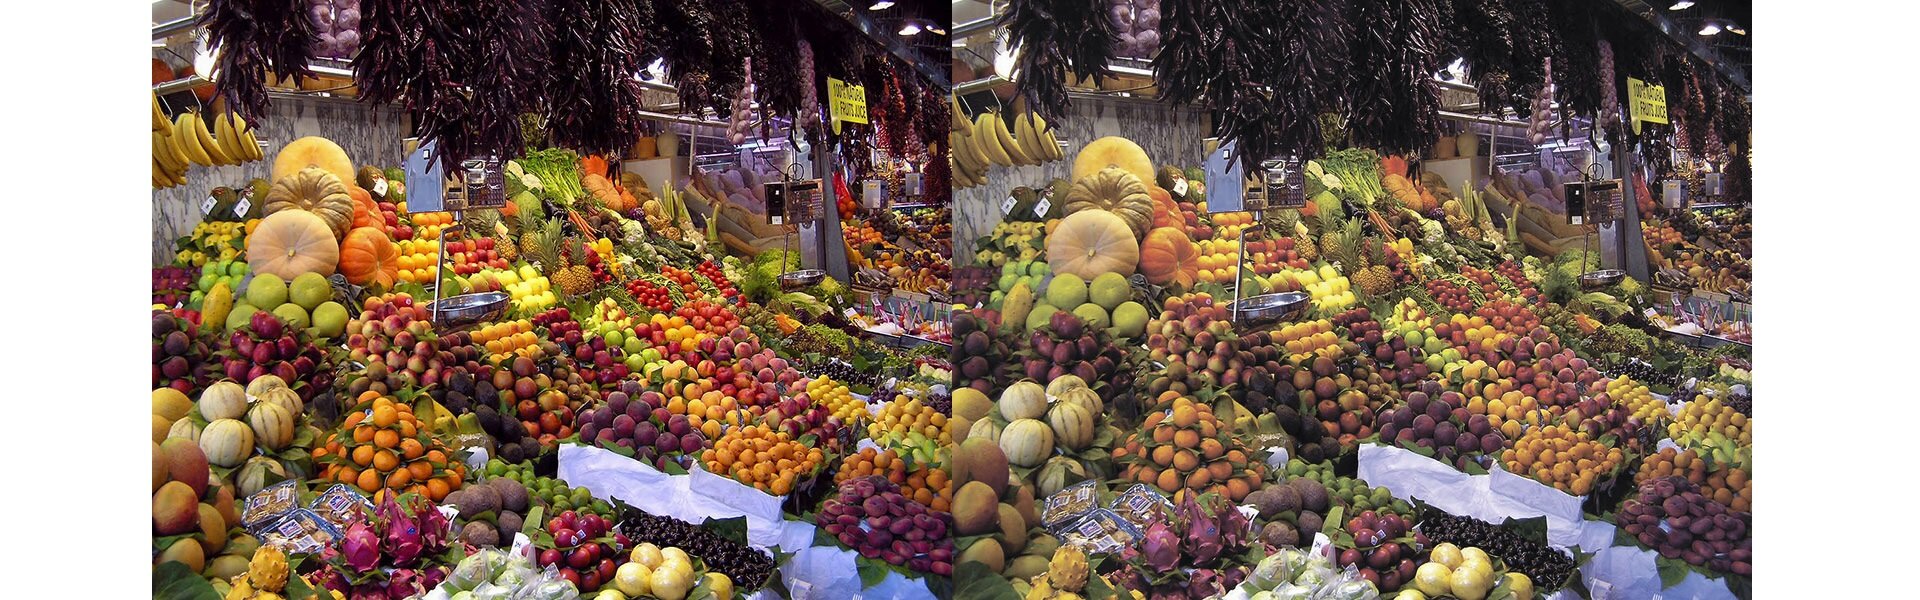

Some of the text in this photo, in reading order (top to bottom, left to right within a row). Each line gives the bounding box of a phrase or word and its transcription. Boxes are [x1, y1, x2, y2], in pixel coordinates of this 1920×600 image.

[846, 85, 864, 102] NATURAL
[1646, 85, 1664, 102] NATURAL
[840, 101, 866, 118] FRUITS JUICE
[1640, 101, 1666, 118] FRUITS JUICE
